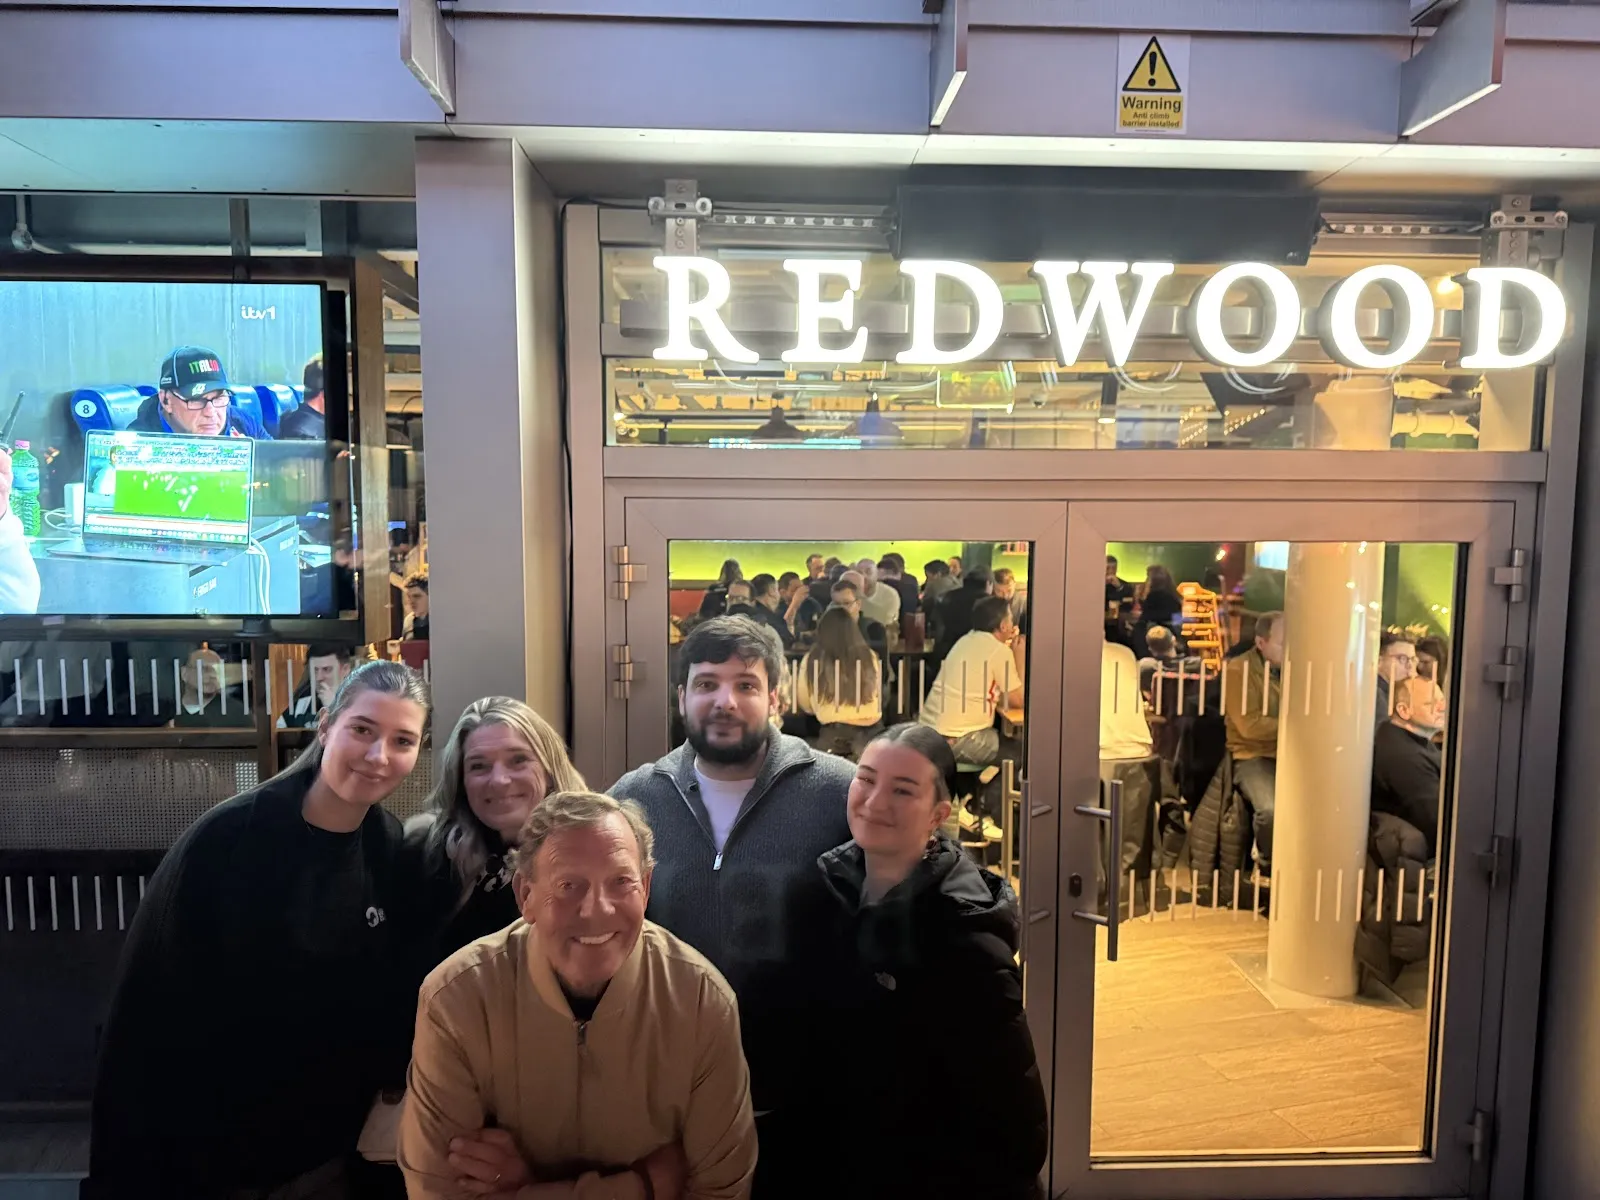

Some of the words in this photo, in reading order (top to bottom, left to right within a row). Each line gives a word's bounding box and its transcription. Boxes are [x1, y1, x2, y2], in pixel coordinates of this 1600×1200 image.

[1122, 96, 1181, 113] Warning
[1148, 120, 1180, 128] installed
[241, 305, 276, 320] itv1
[653, 256, 1567, 369] REDWOOD
[82, 404, 90, 414] 8
